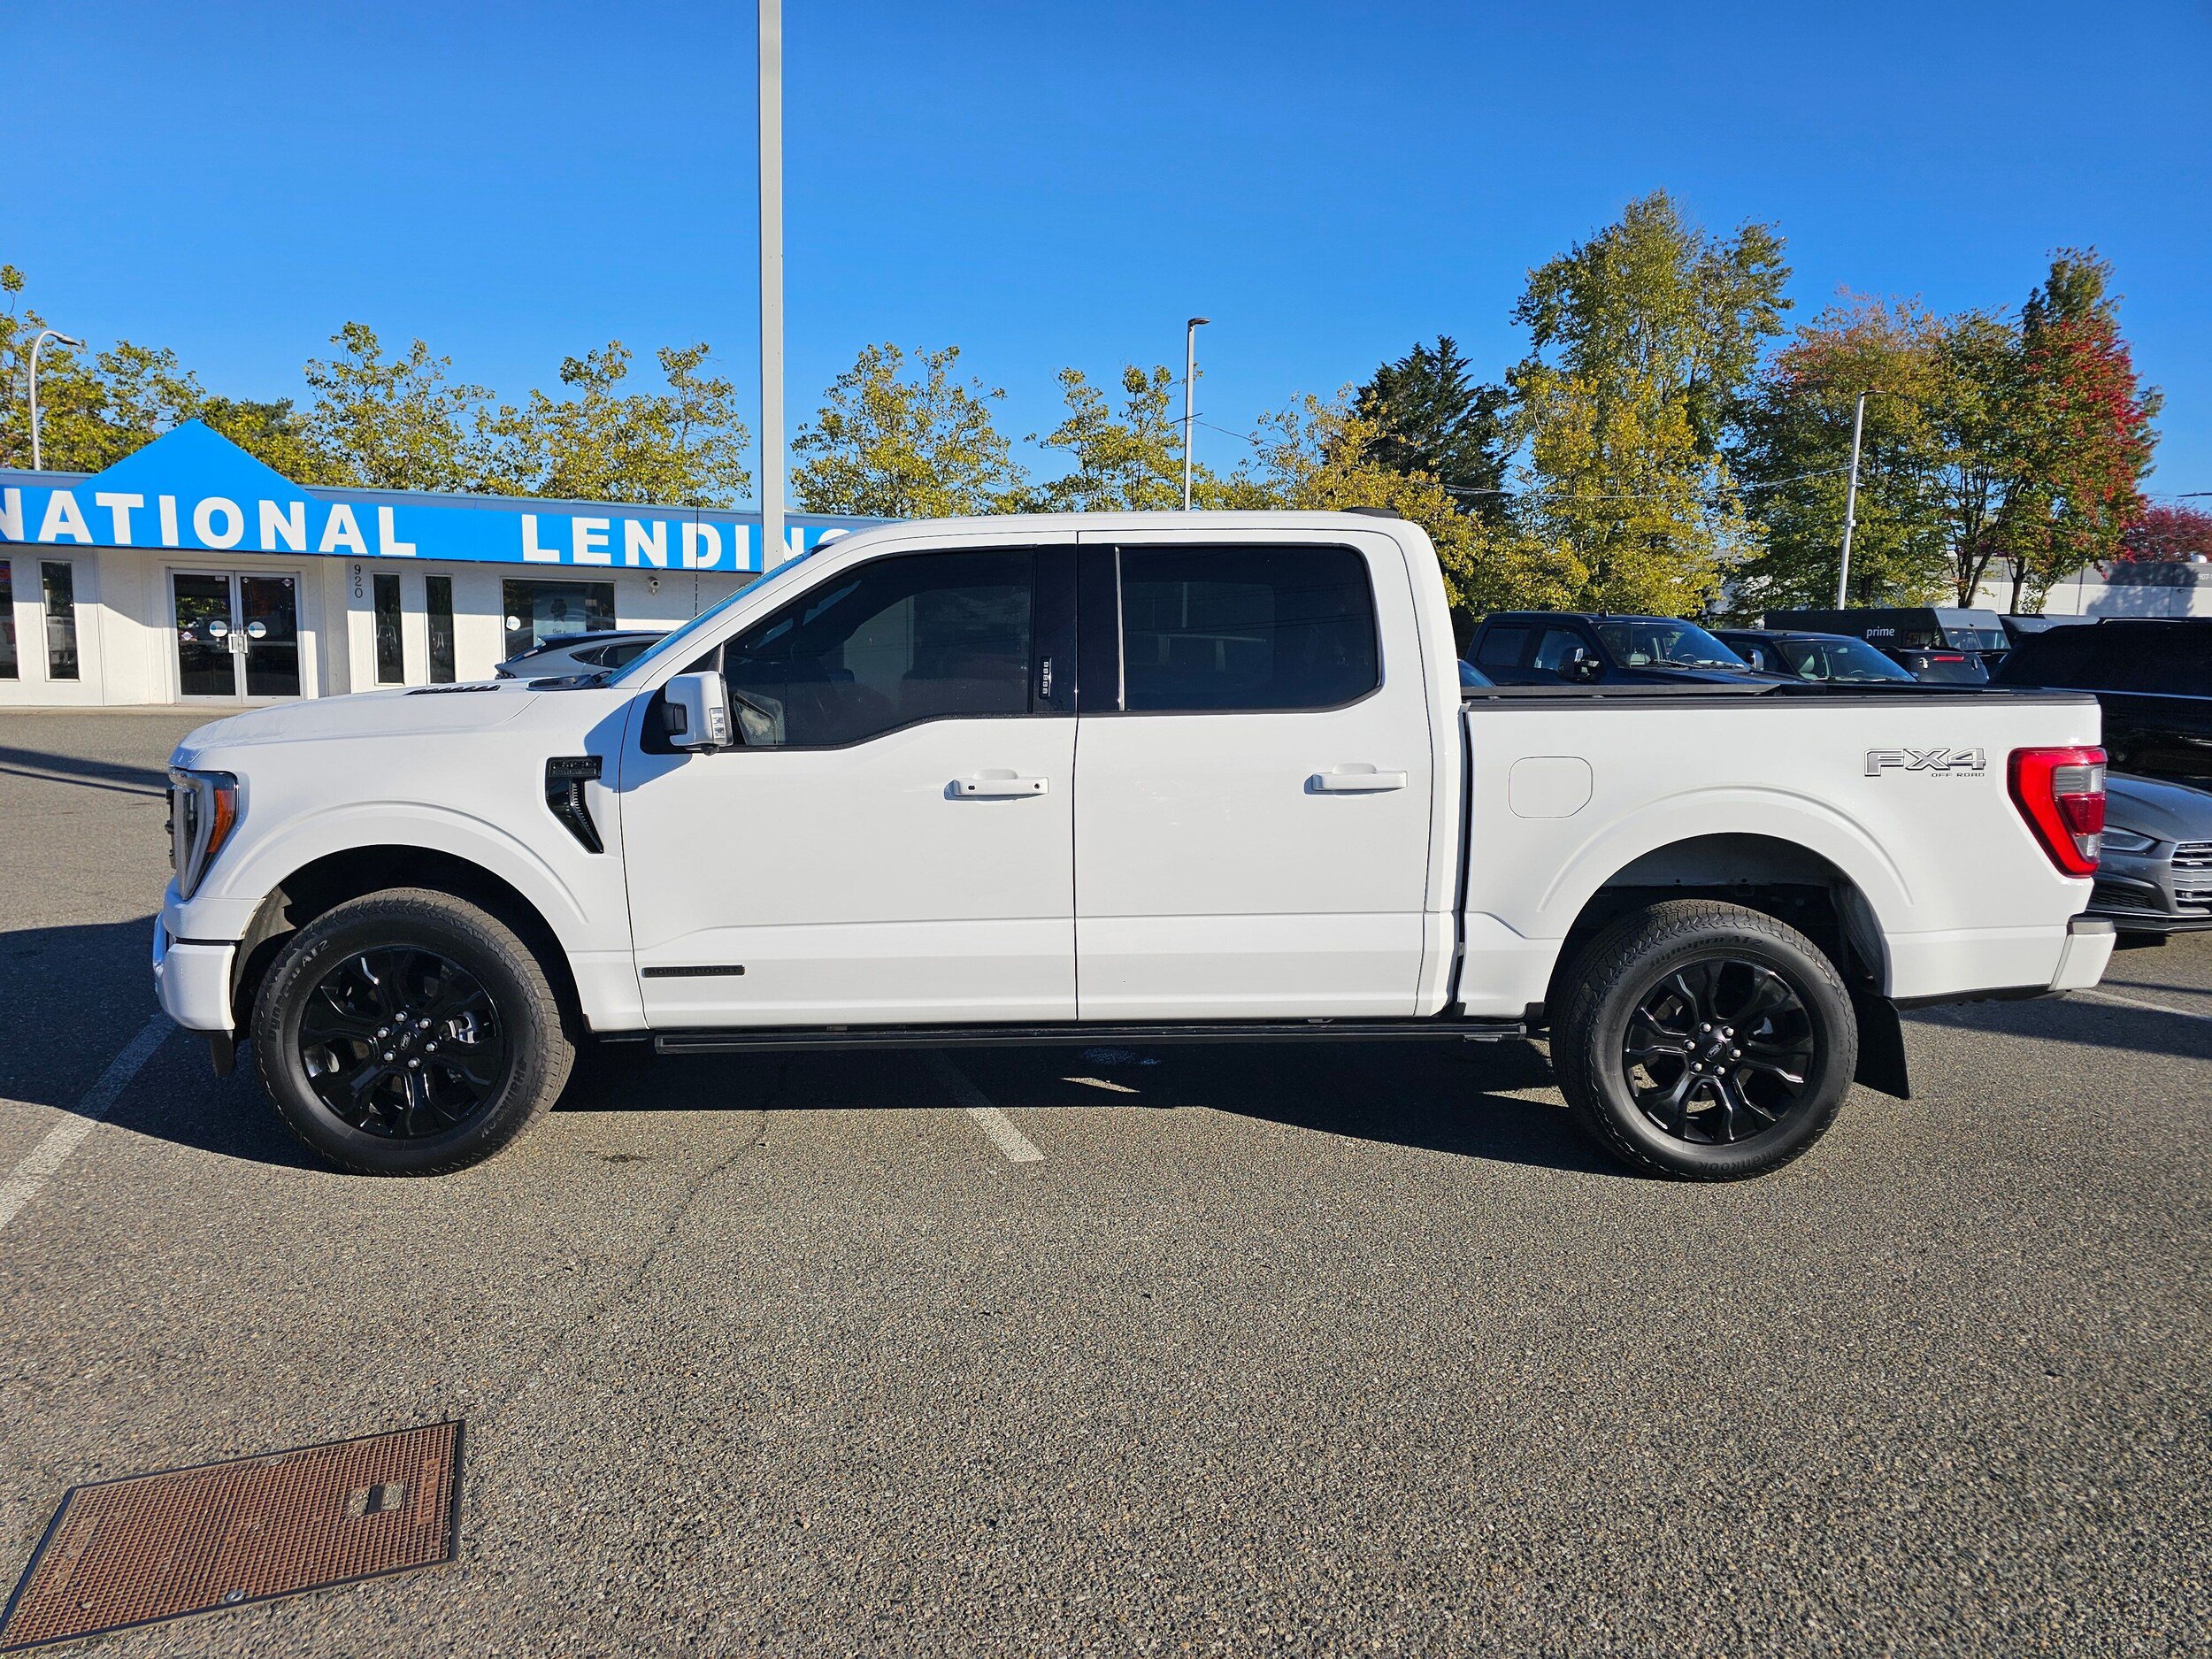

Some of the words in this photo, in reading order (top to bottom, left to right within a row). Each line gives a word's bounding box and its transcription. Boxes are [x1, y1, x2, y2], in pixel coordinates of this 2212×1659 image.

[521, 514, 849, 570] LENDI
[354, 564, 363, 599] 920
[1866, 626, 1895, 639] prime
[1864, 748, 1986, 777] FX4
